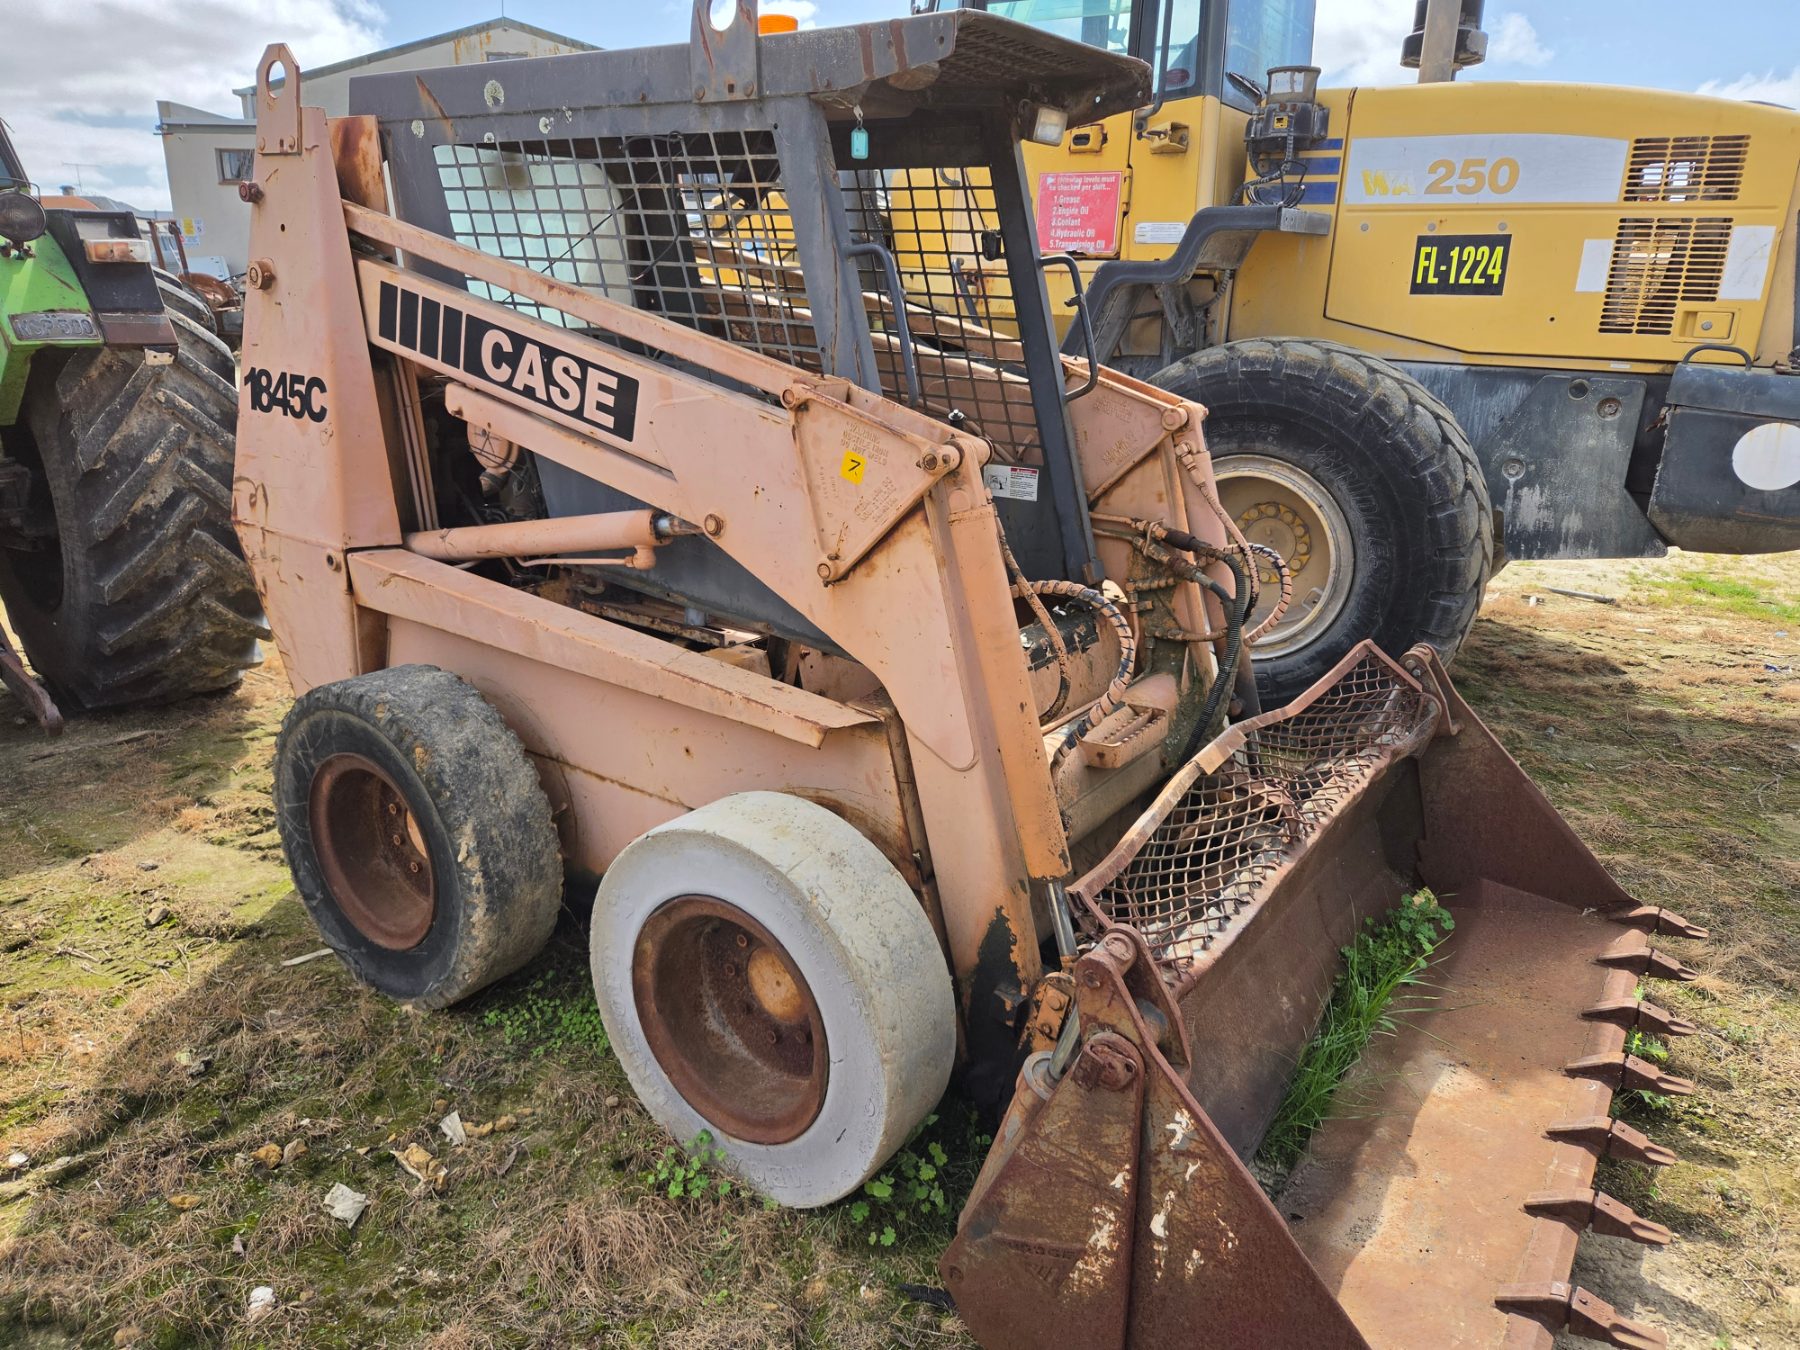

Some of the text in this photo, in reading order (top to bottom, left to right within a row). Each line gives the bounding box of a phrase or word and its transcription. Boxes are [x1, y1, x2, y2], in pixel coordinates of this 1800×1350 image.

[1424, 157, 1520, 195] 250
[1080, 206, 1089, 215] Oil
[1086, 229, 1095, 237] Oil
[1096, 240, 1105, 248] Oil
[1415, 245, 1505, 285] FL-1224
[244, 366, 328, 424] 1845C
[481, 329, 619, 430] CASE
